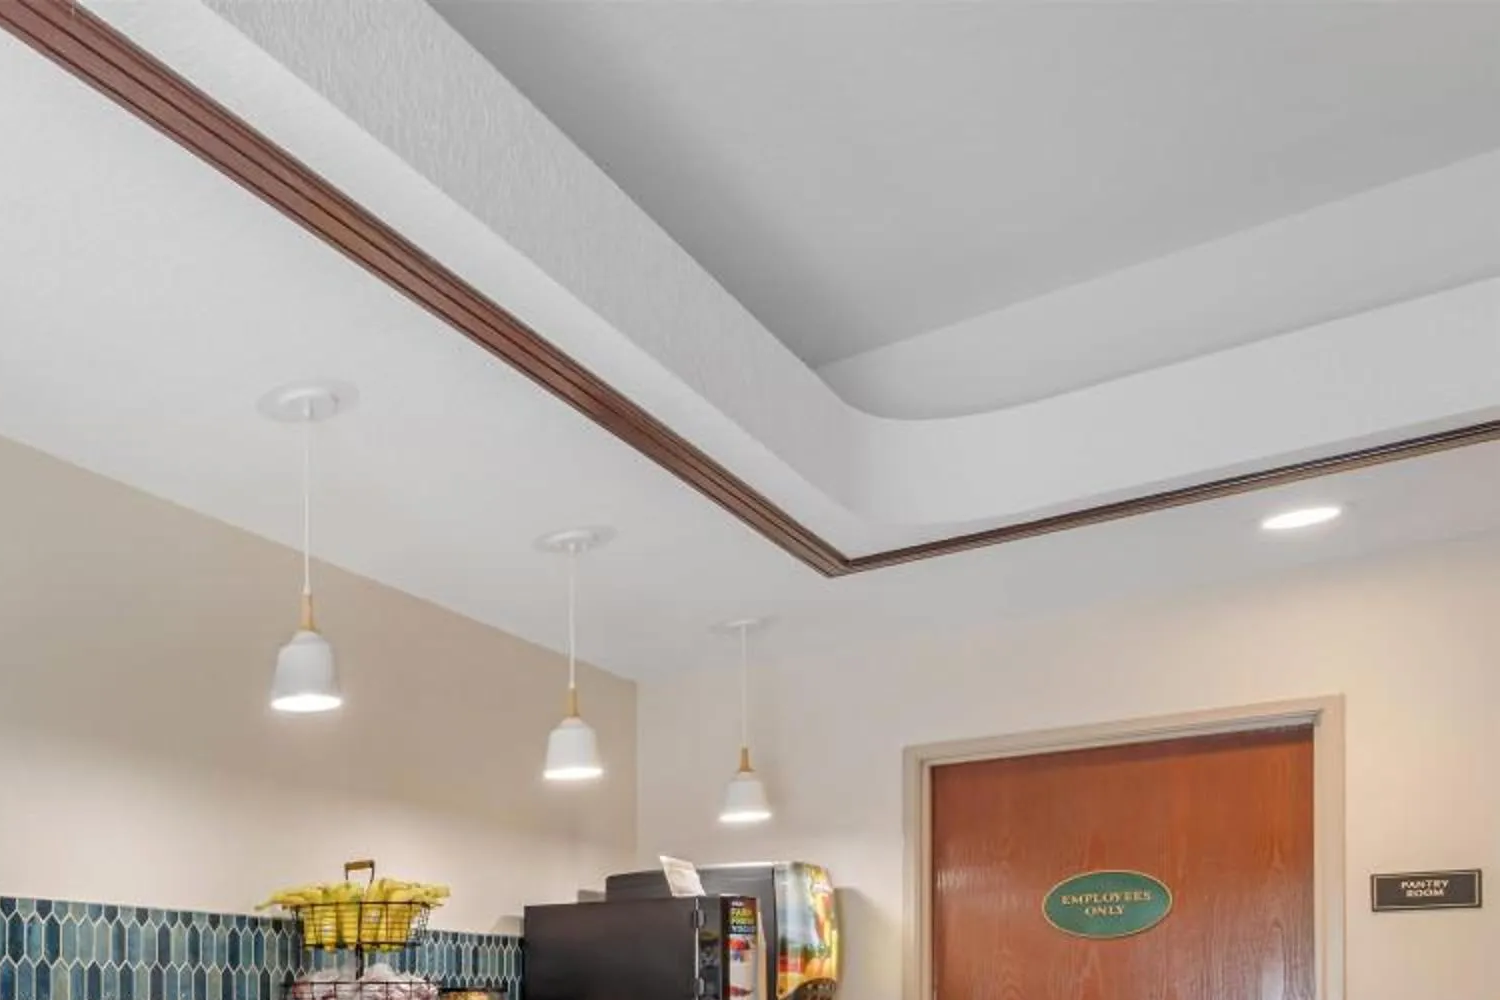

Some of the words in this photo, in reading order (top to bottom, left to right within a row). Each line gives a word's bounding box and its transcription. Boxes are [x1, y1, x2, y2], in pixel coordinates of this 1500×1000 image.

[1401, 880, 1449, 889] PANTRY
[1061, 889, 1151, 904] EMPLOYEES
[1405, 889, 1445, 897] ROOM
[1084, 905, 1125, 918] ONLY
